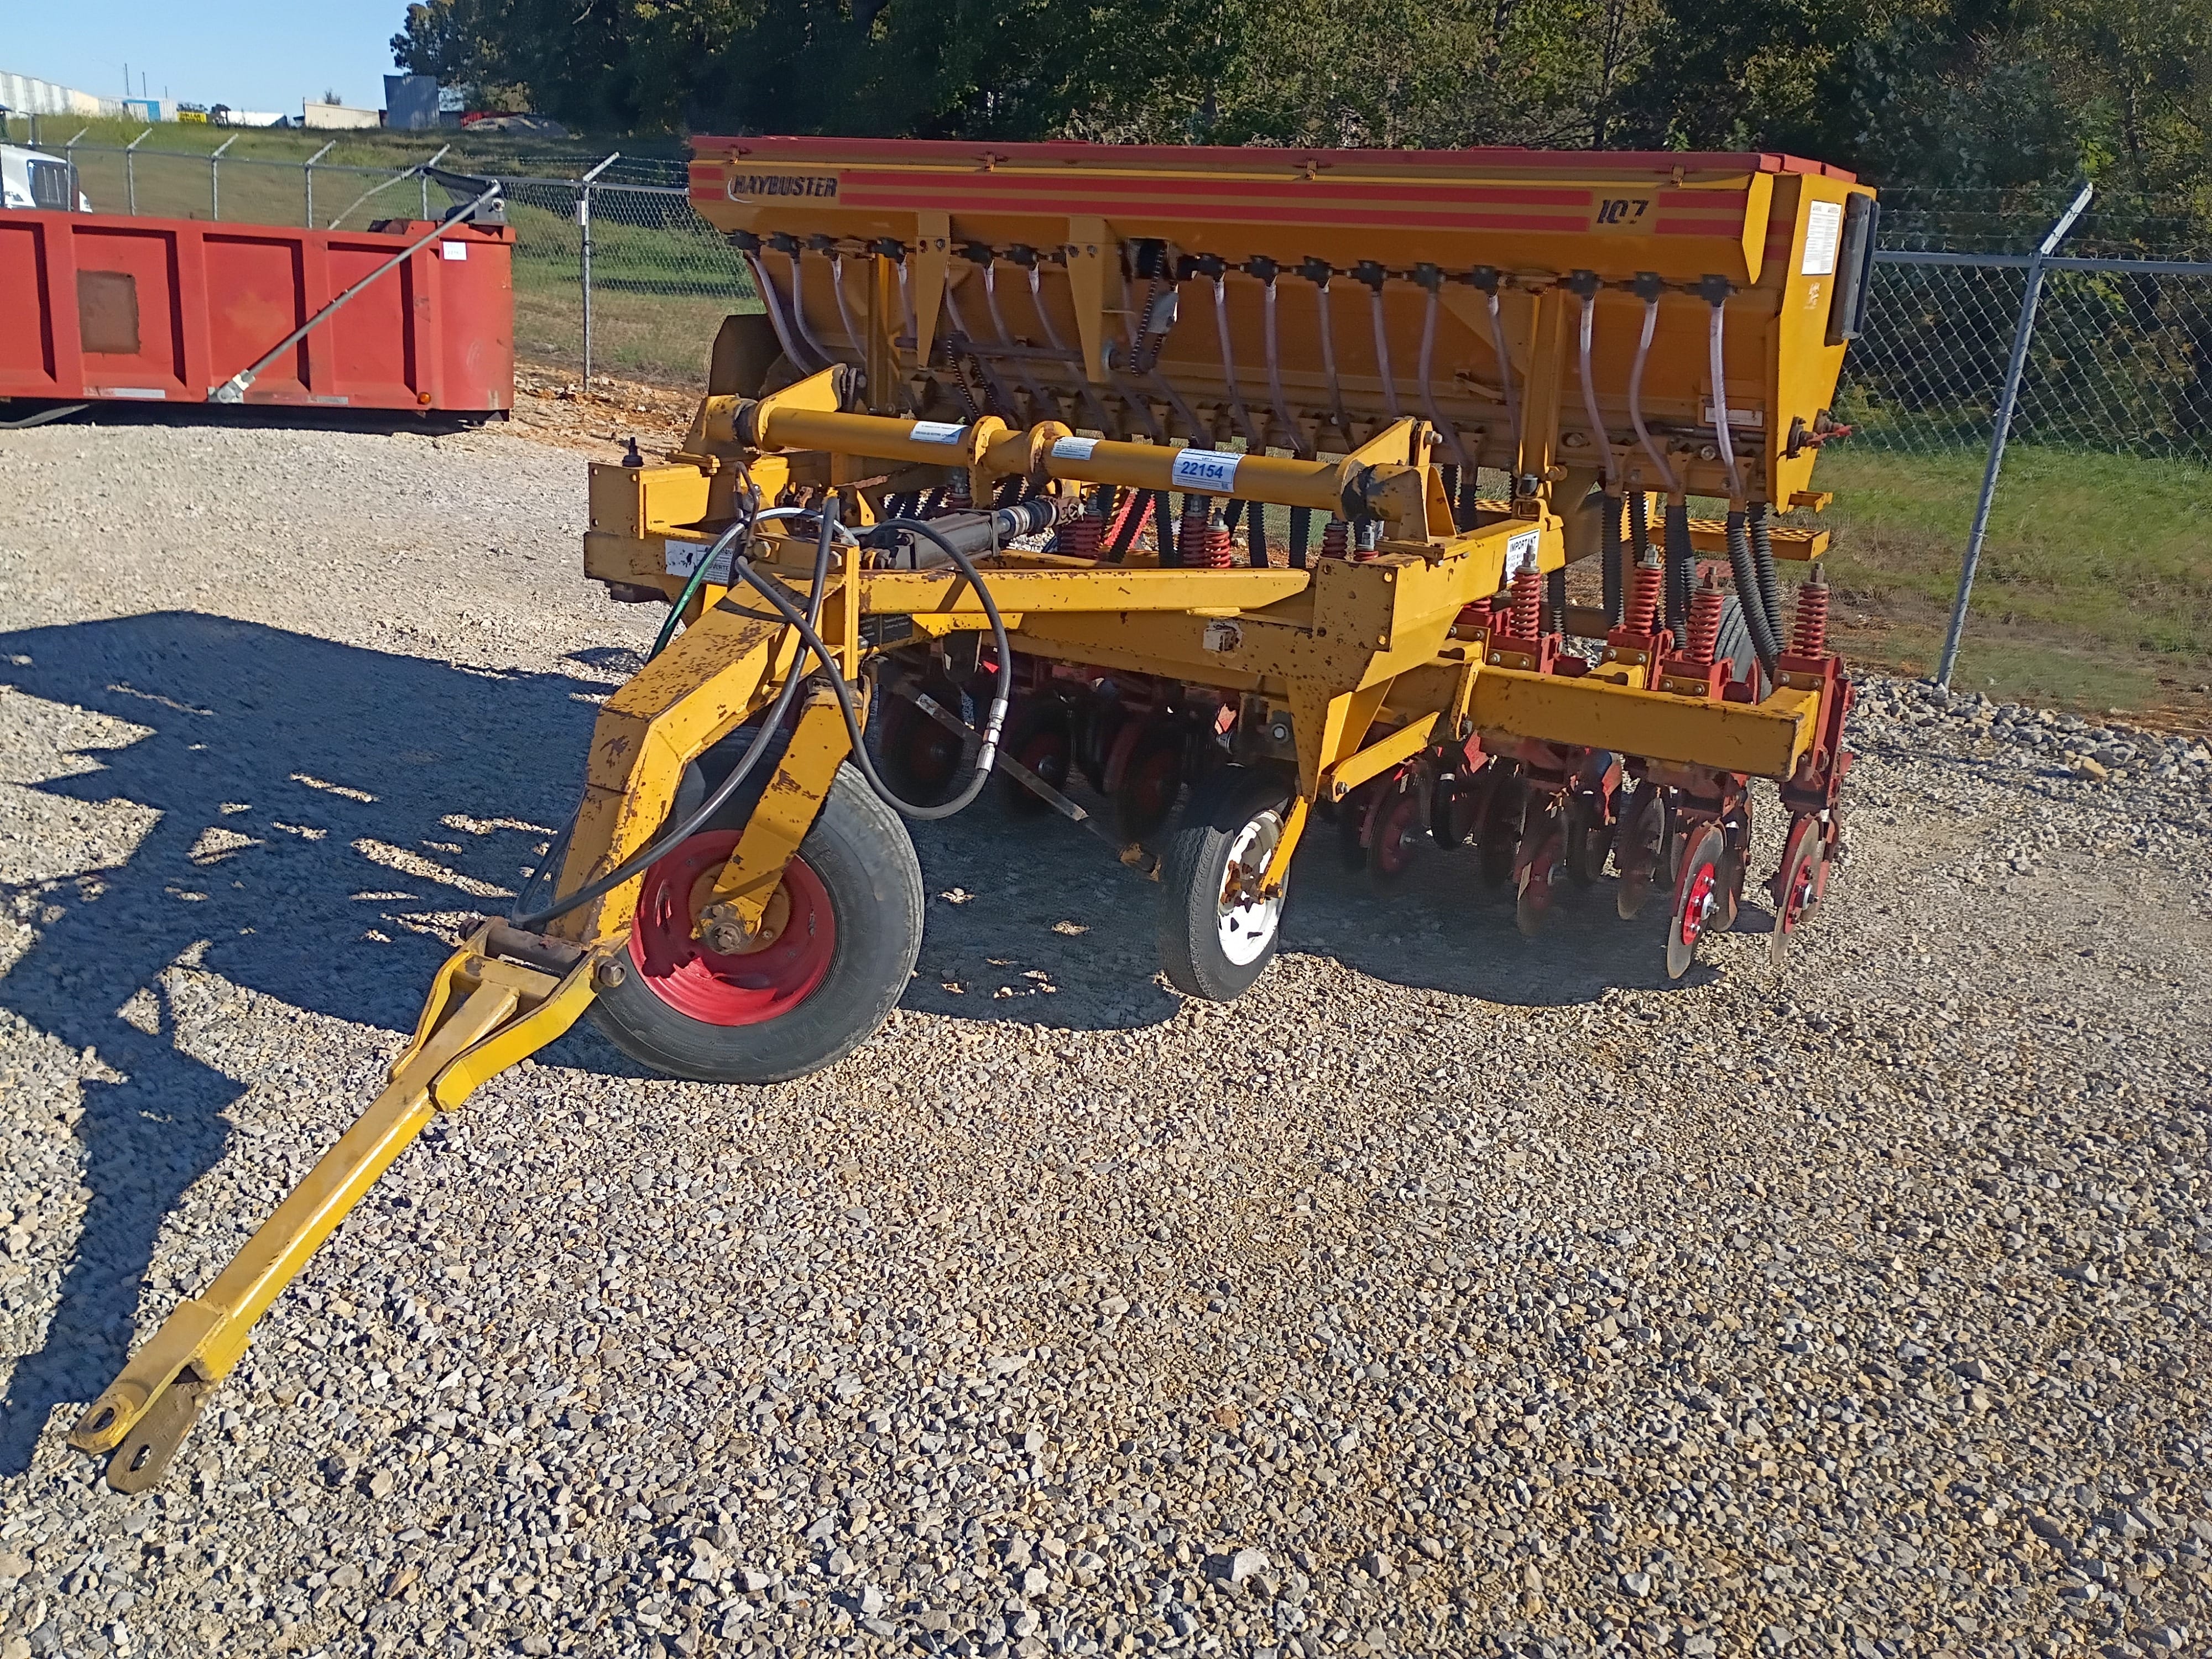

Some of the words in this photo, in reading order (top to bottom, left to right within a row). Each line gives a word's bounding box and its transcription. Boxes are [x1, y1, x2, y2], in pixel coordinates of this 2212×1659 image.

[733, 175, 837, 197] HAYBUSTER
[1597, 200, 1649, 225] 107
[1181, 461, 1224, 478] 22154
[1510, 536, 1536, 552] IMPORTANT
